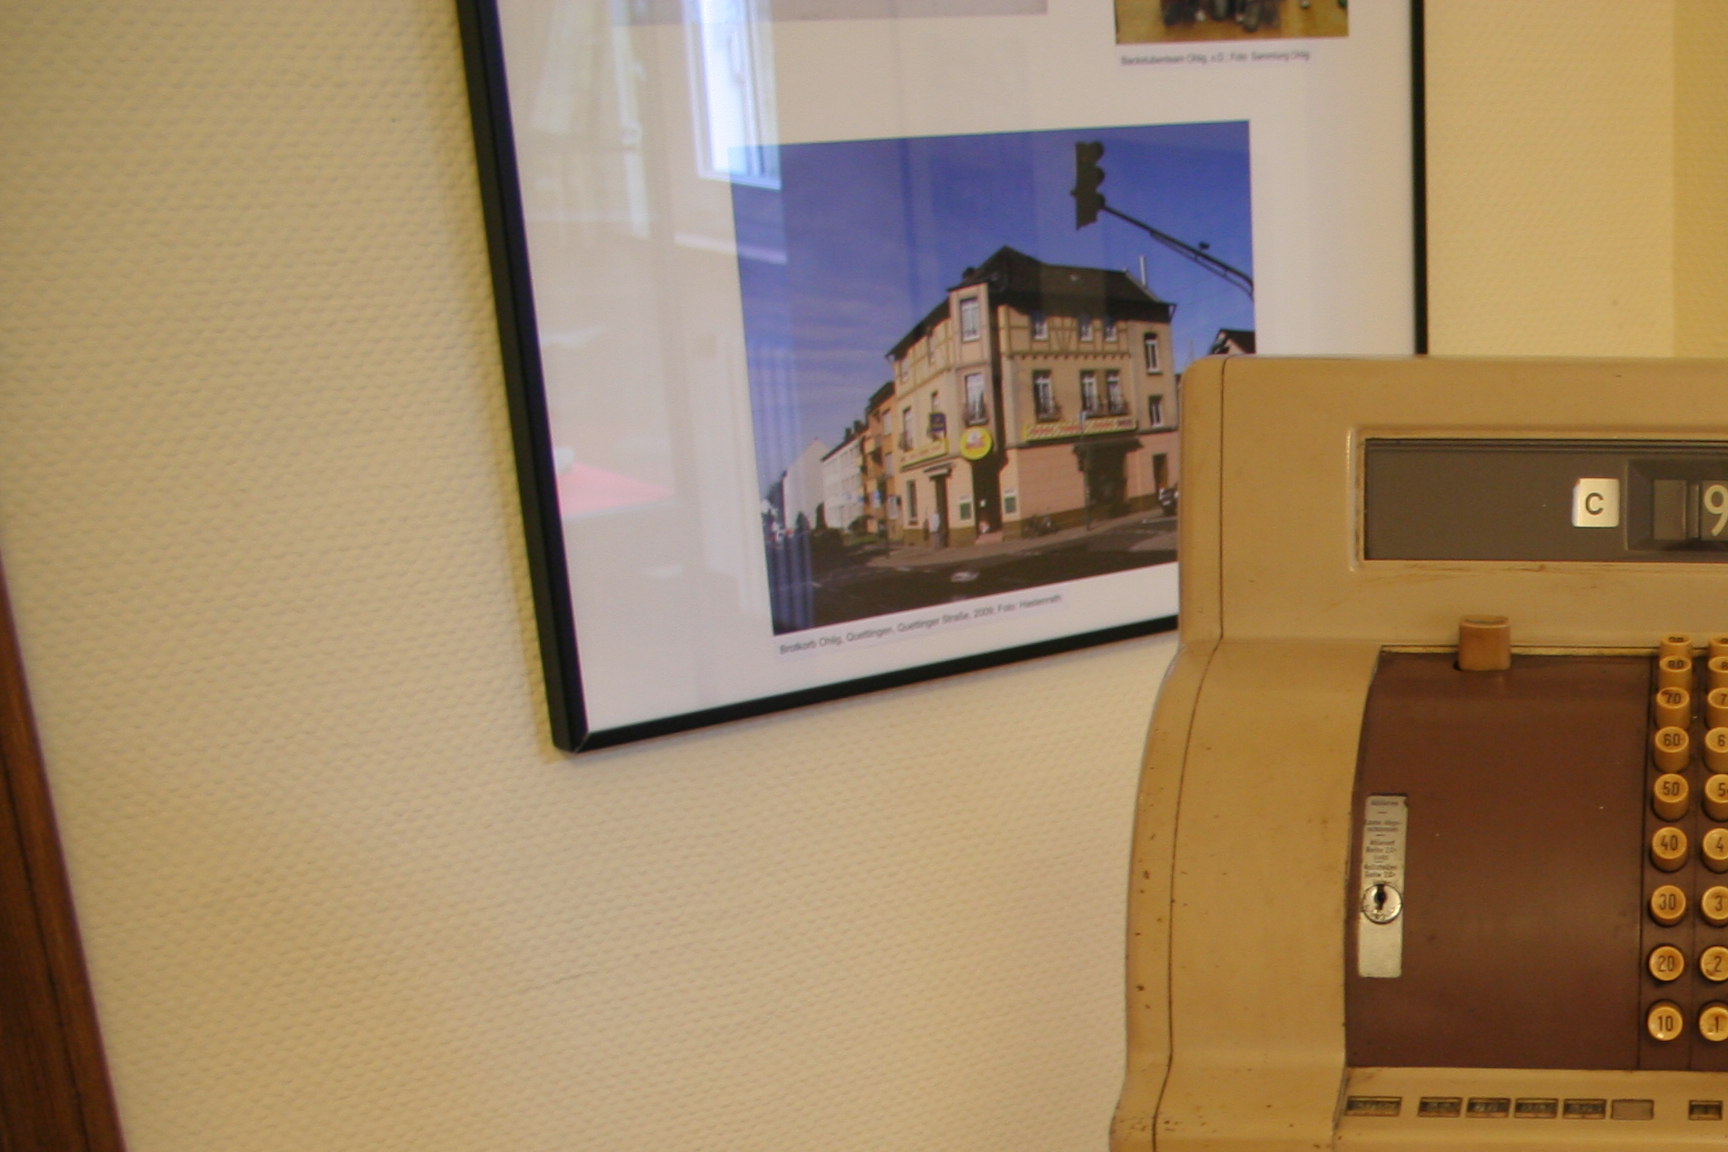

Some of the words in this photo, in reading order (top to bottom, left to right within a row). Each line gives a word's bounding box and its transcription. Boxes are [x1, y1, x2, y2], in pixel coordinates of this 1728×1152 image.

[1585, 491, 1605, 517] C
[1666, 691, 1682, 704] 70
[1664, 733, 1681, 747] 60
[1717, 734, 1726, 747] 6
[1663, 781, 1680, 796] 50
[1718, 782, 1726, 797] 5
[1660, 835, 1678, 851] 40
[1716, 836, 1724, 849] 4
[1659, 893, 1677, 910] 30
[1715, 895, 1723, 911] 3
[1658, 955, 1675, 972] 20
[1714, 956, 1722, 973] 2
[1657, 1016, 1674, 1032] 10
